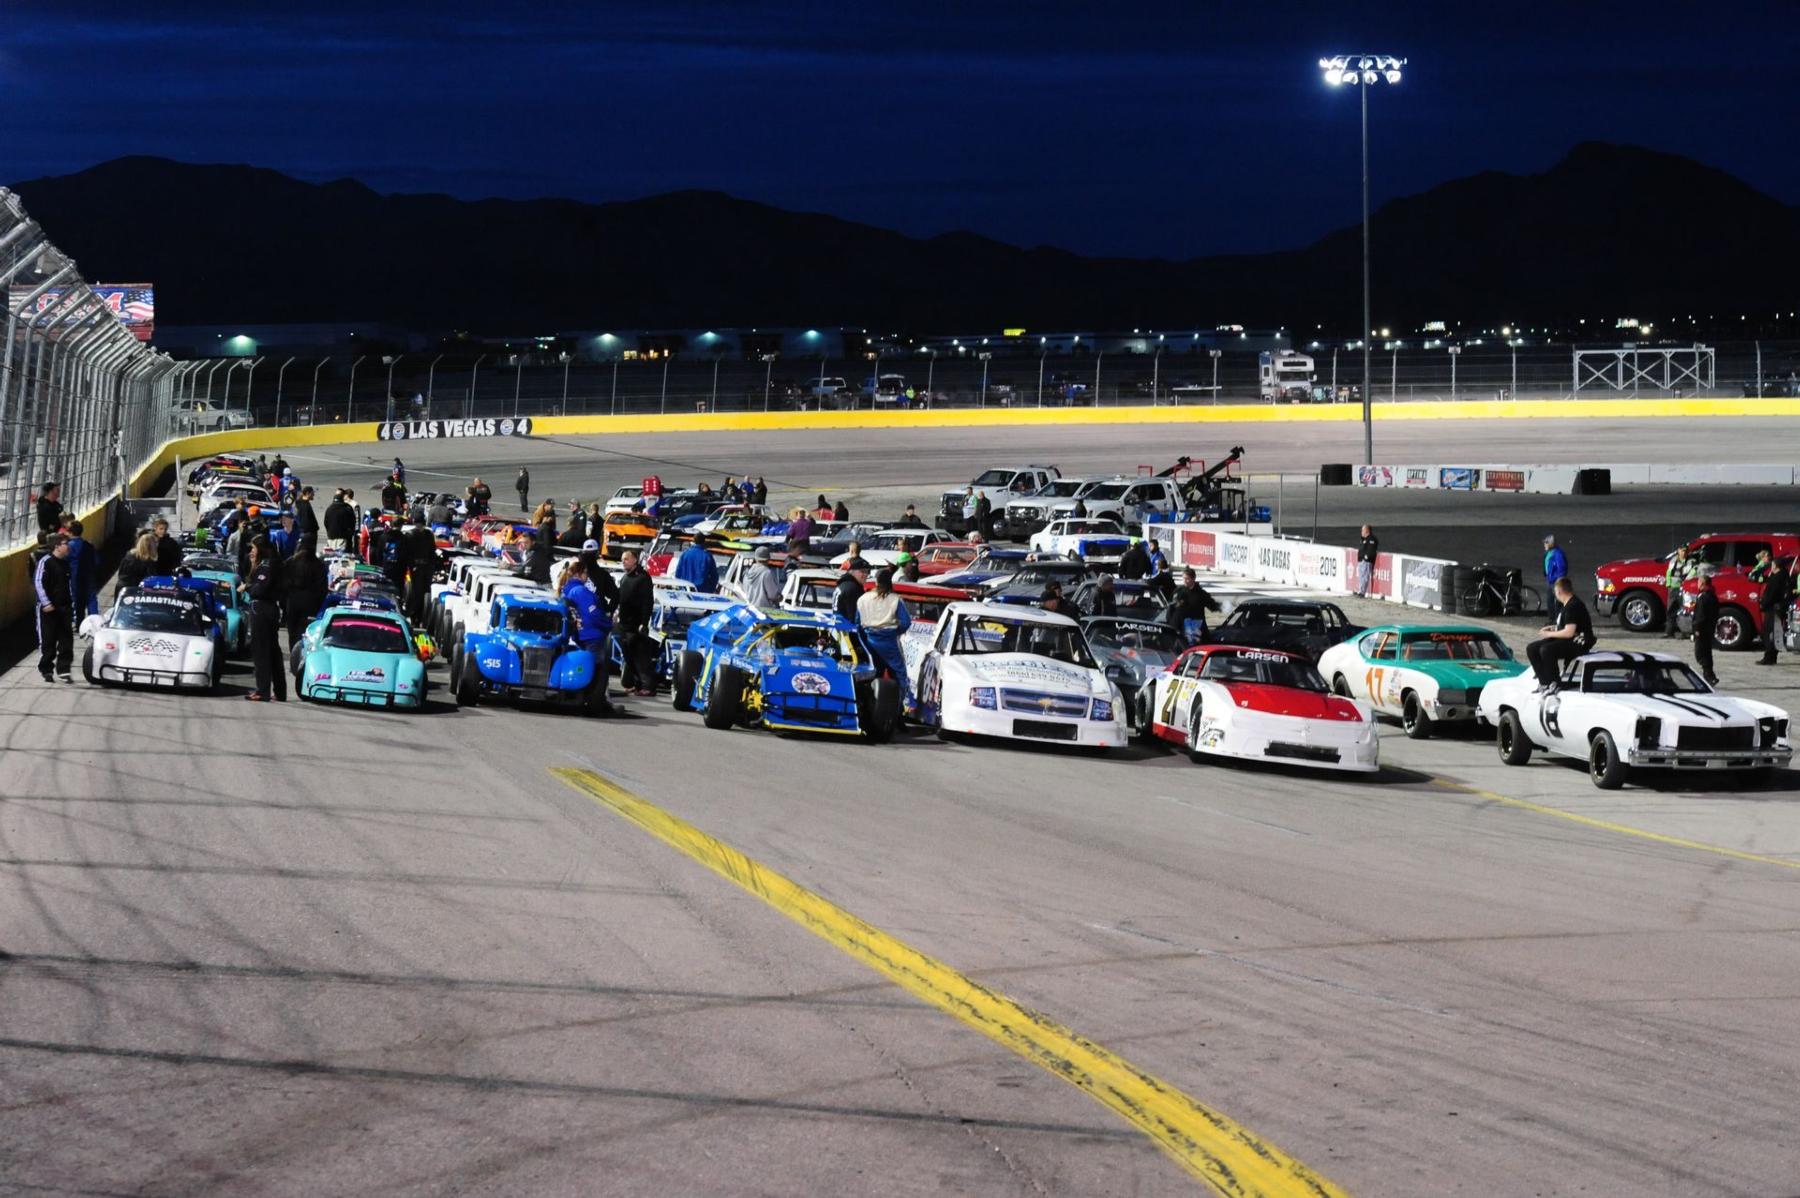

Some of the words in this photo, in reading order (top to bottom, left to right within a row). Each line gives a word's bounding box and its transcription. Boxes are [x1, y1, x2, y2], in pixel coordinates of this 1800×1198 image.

[380, 423, 390, 440] 4
[408, 421, 438, 439] LAS
[443, 419, 496, 438] VEGAS
[516, 418, 528, 435] 4
[1223, 543, 1248, 564] NASCAR
[1260, 547, 1271, 567] LAS
[1272, 549, 1291, 570] VEGAS
[1319, 556, 1337, 577] 2019
[134, 596, 183, 607] SABASTIAN
[1115, 622, 1163, 633] LARSEN
[1236, 651, 1290, 663] LARSEN
[1366, 667, 1385, 707] 17
[1161, 678, 1184, 726] 21
